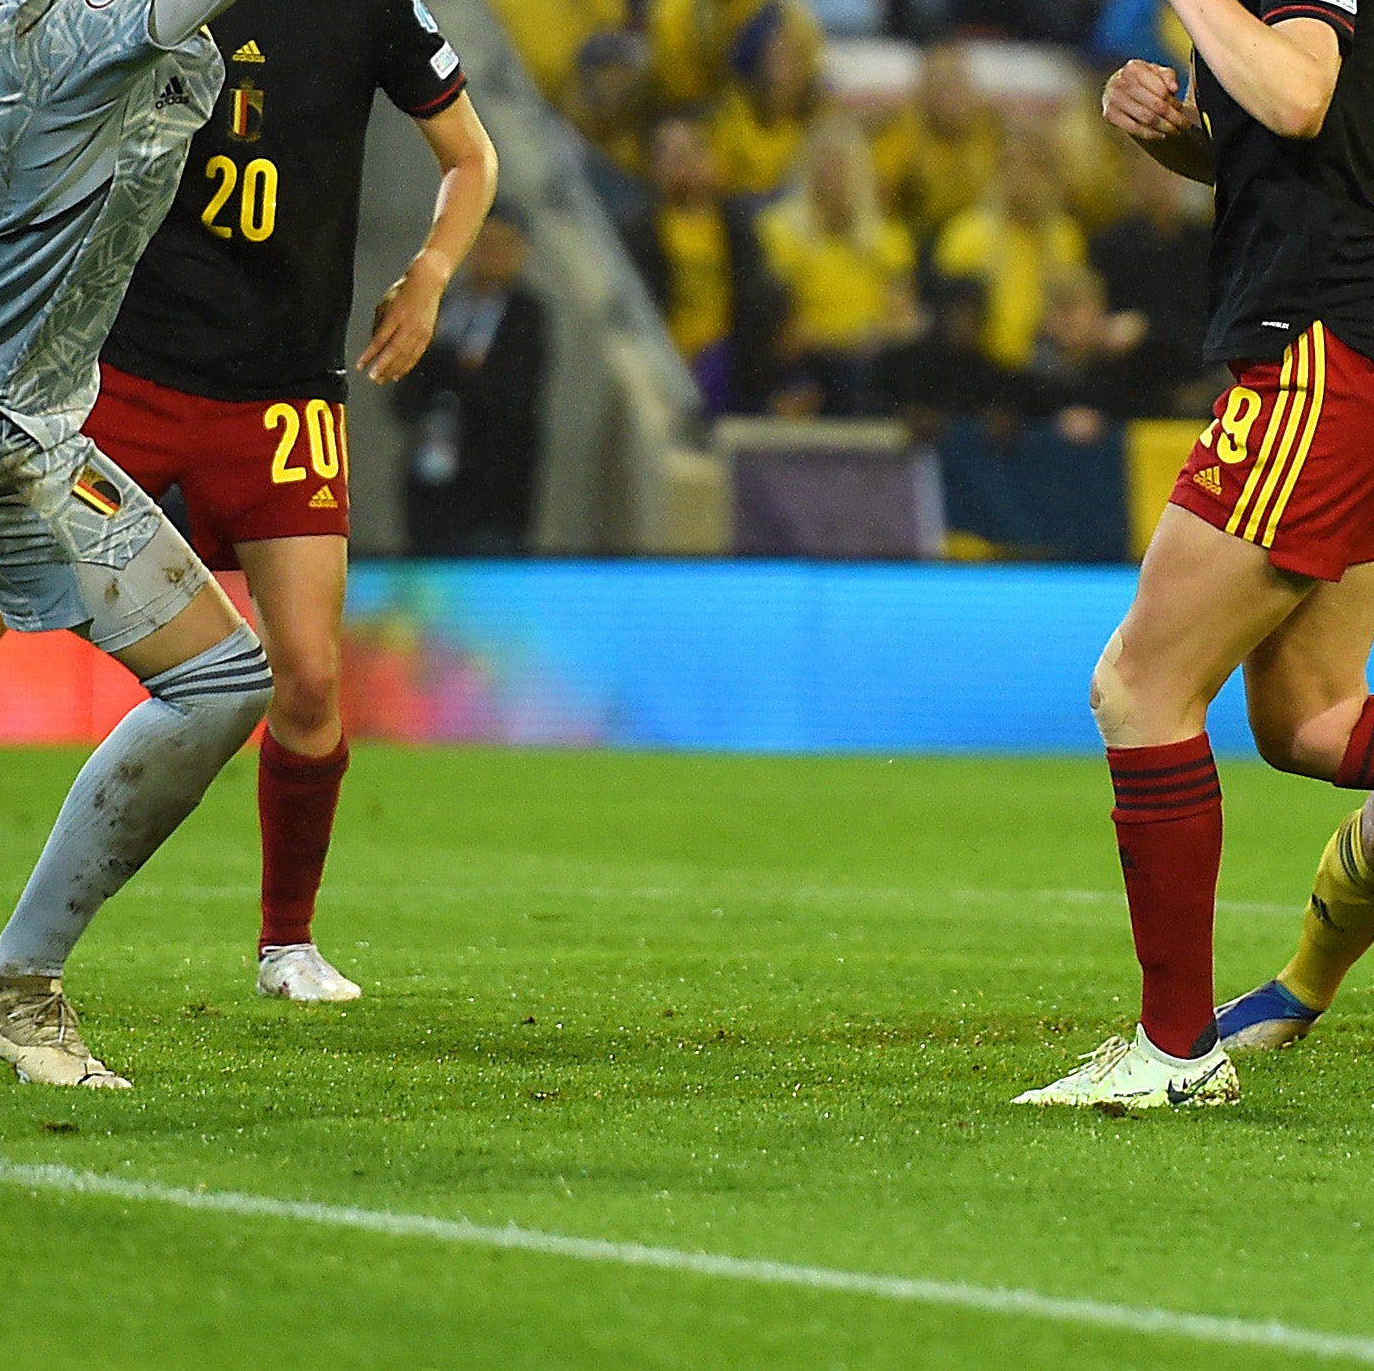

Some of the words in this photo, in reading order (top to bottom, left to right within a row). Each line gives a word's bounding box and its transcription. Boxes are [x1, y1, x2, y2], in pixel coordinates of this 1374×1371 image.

[232, 54, 266, 63] adidas
[201, 155, 278, 243] 20
[264, 399, 340, 484] 20
